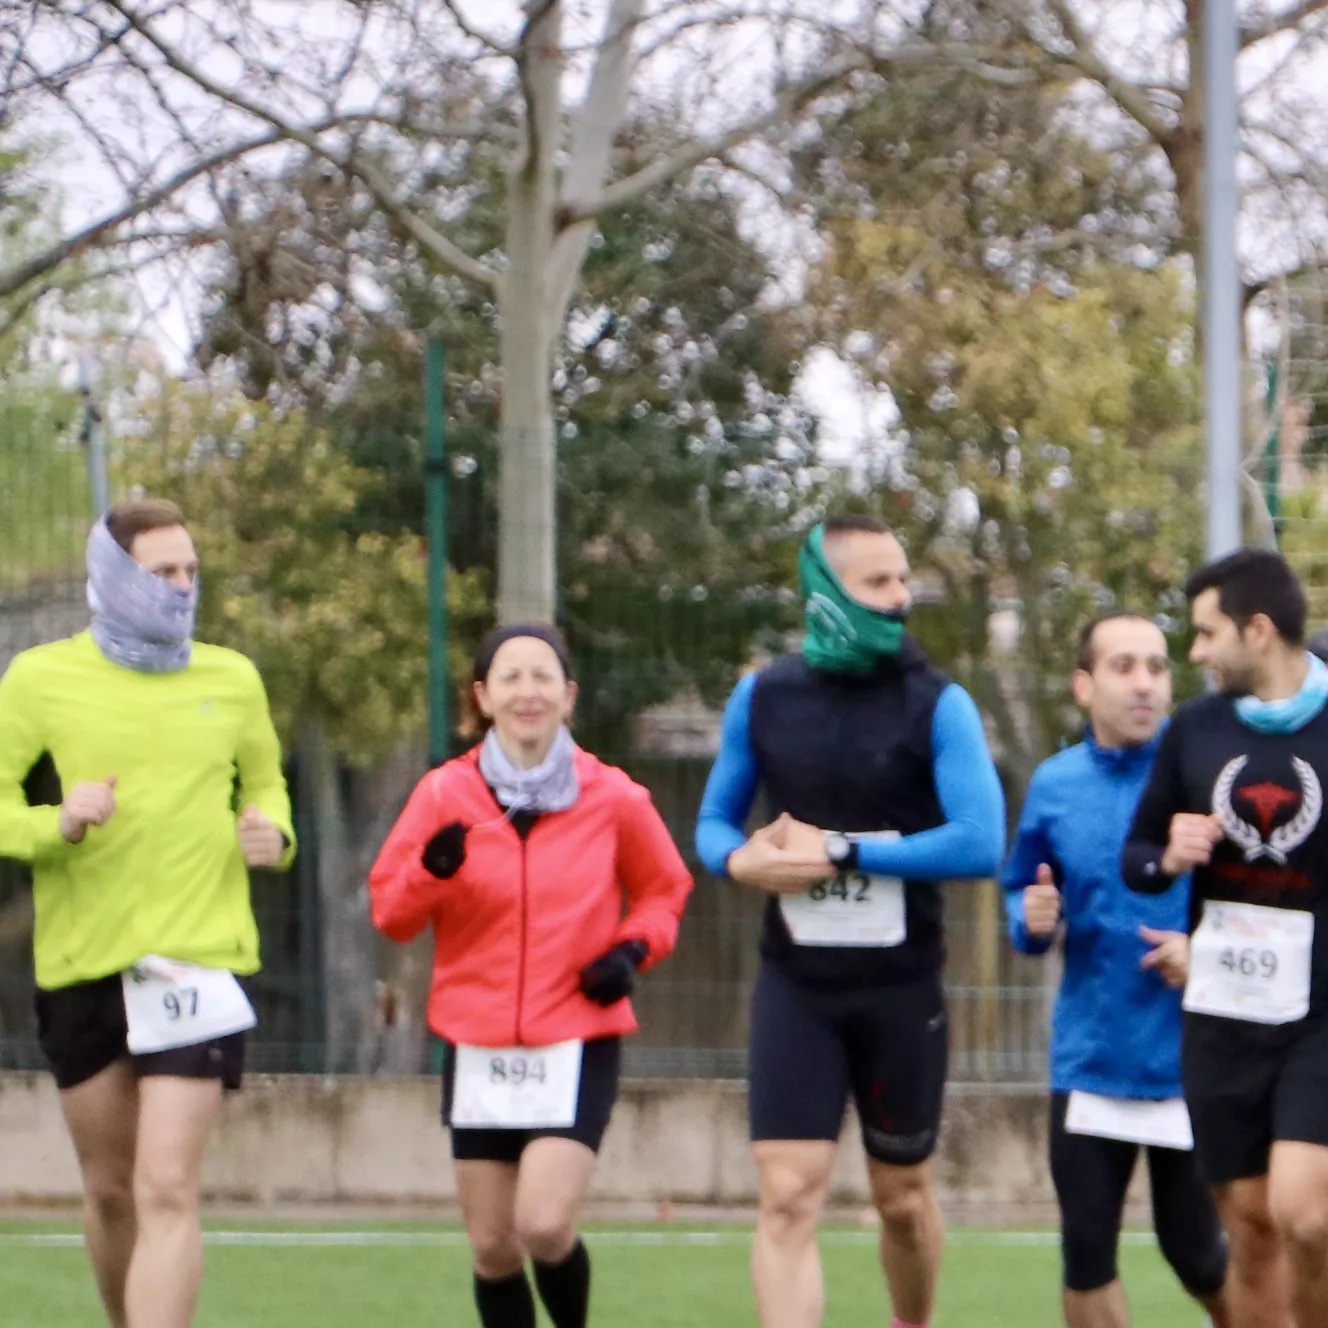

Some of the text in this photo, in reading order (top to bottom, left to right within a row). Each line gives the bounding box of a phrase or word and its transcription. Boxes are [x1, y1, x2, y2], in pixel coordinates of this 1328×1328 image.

[1218, 946, 1279, 979] 469
[163, 987, 199, 1021] 97
[488, 1056, 547, 1086] 894
